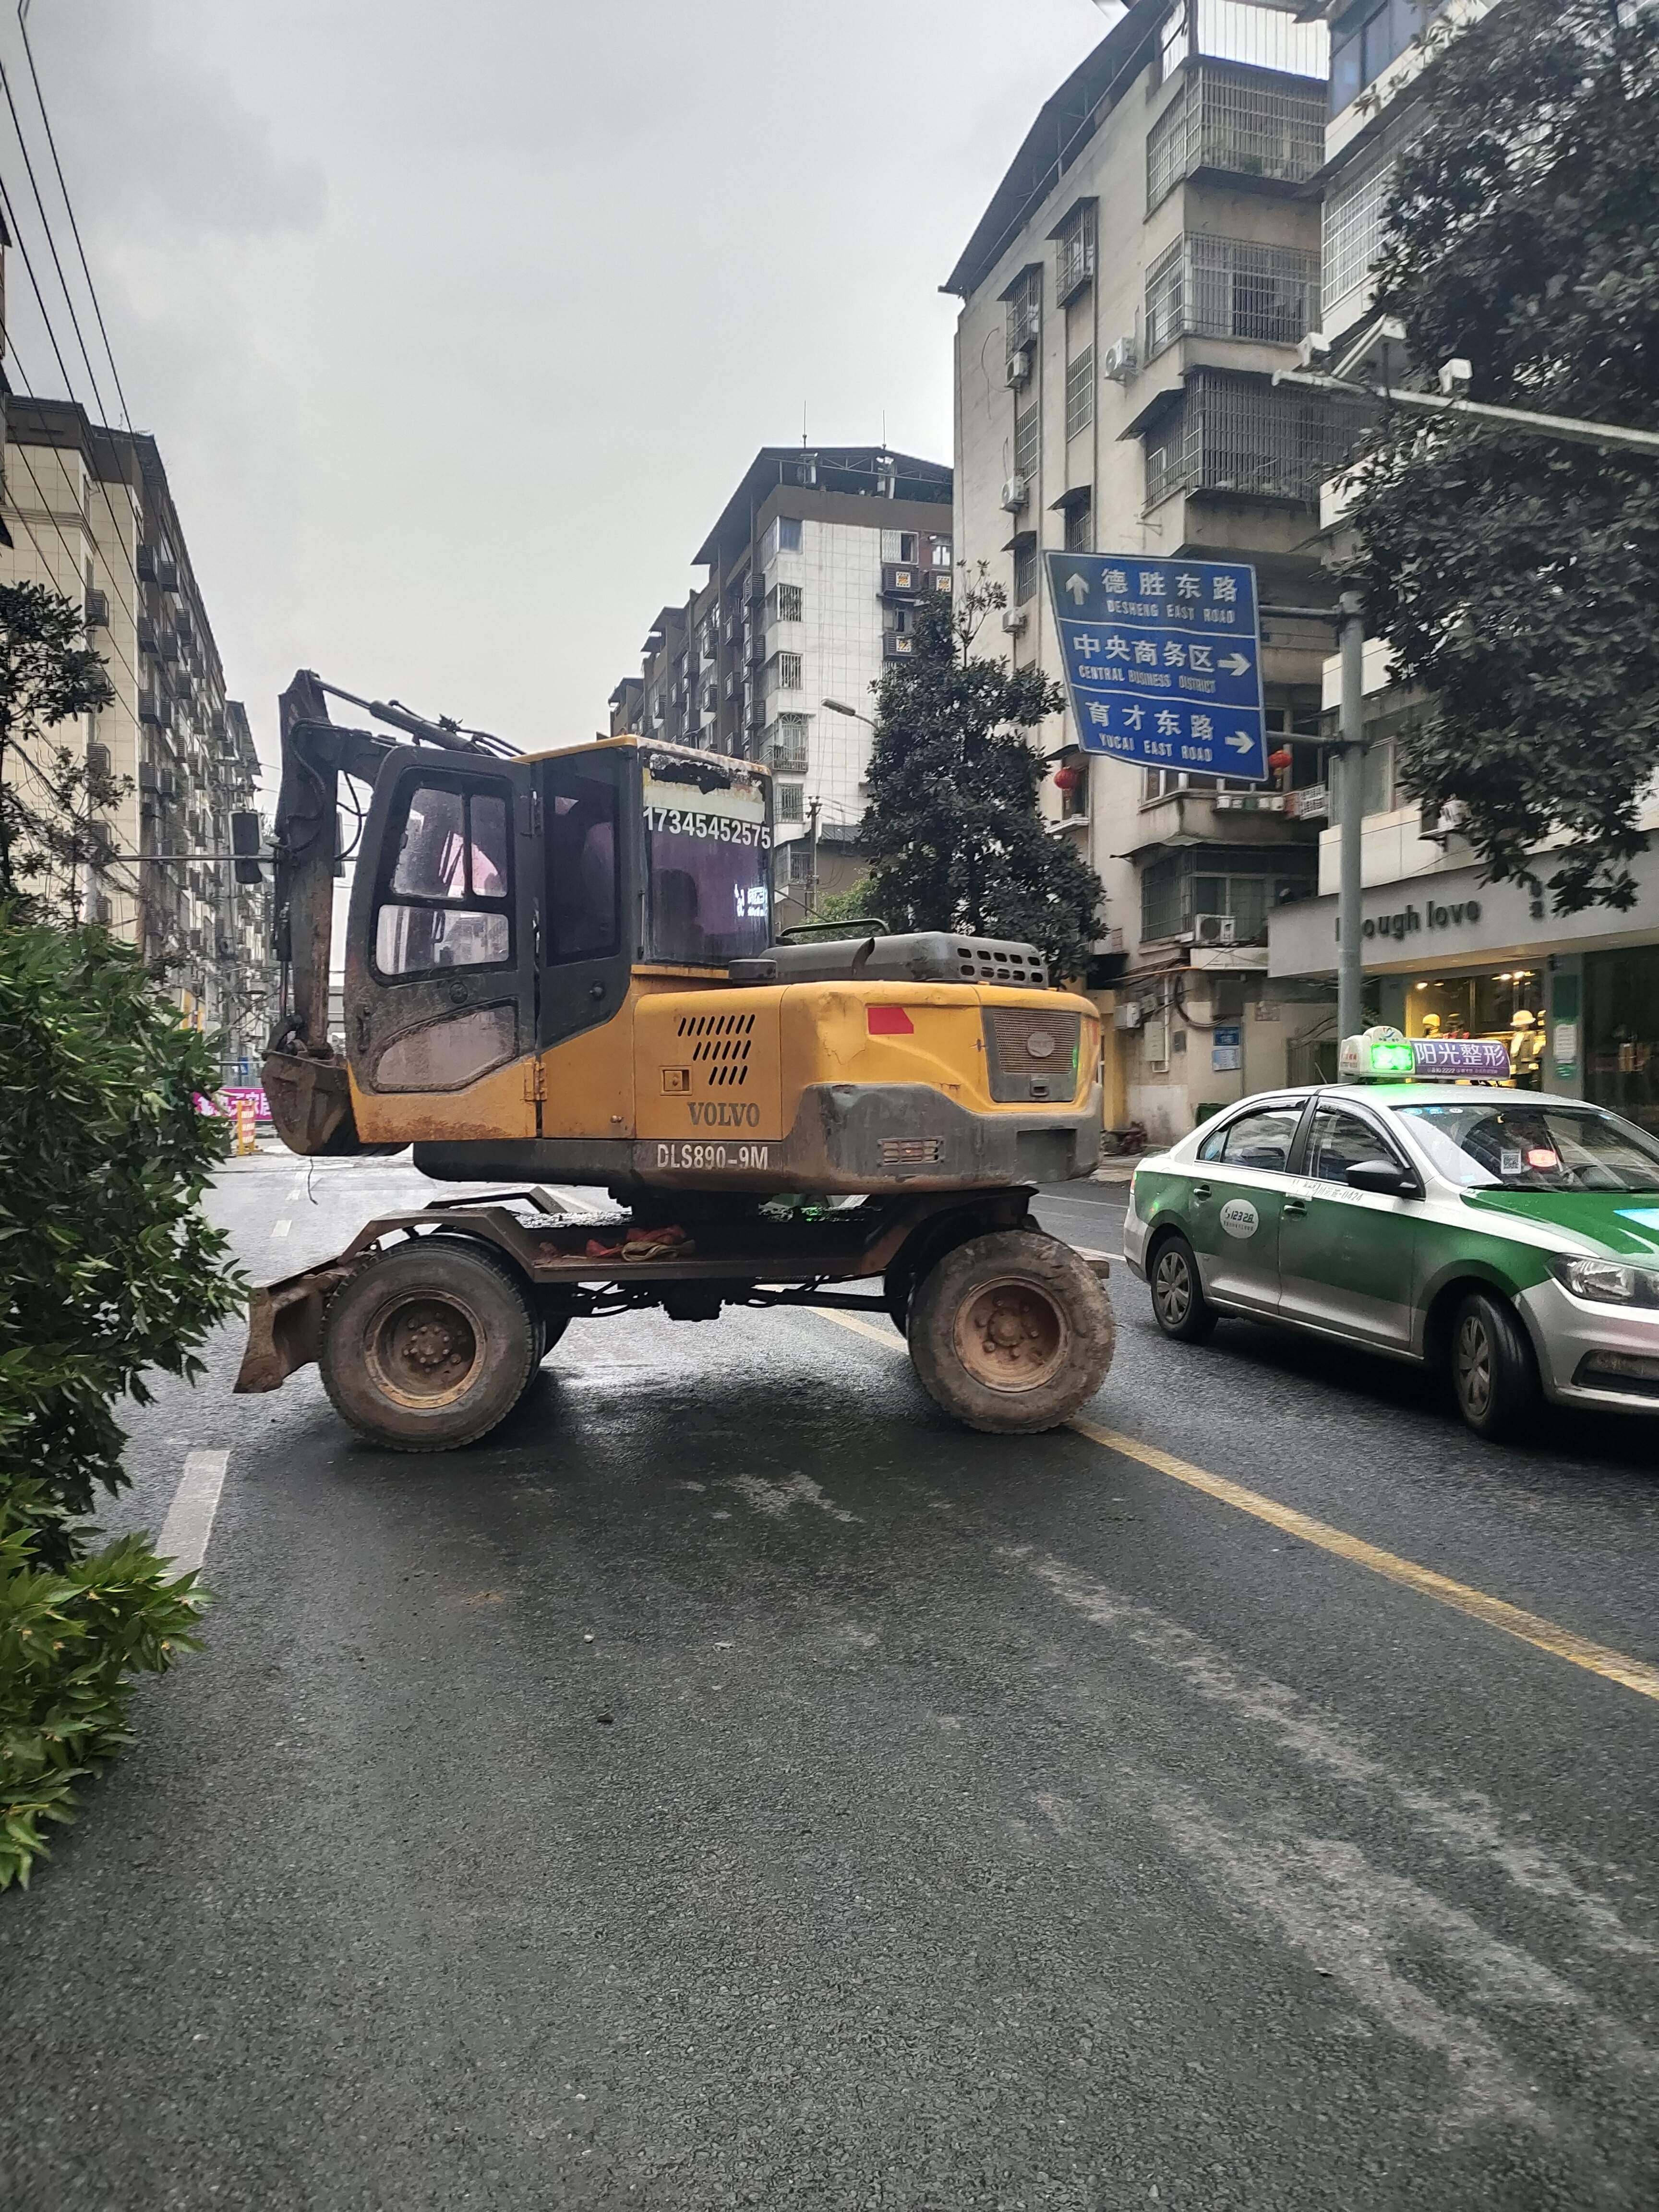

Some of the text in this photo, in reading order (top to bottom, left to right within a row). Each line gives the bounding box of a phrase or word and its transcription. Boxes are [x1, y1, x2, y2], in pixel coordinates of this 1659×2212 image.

[1101, 568, 1238, 602] 德胜东路
[1106, 600, 1235, 624] DESHENG EAST ROAD
[1073, 633, 1215, 673] 中央商务区
[1079, 664, 1216, 693] CENTRAL BUSINESS DISTRICT
[1085, 701, 1214, 741] 育才东路
[1099, 733, 1212, 762] YUCAI EAST ROAD
[643, 807, 771, 849] 17345452575
[1414, 1043, 1505, 1066] 阳光整形
[687, 1102, 760, 1127] VOLVO
[657, 1144, 768, 1170] DLS890-9M
